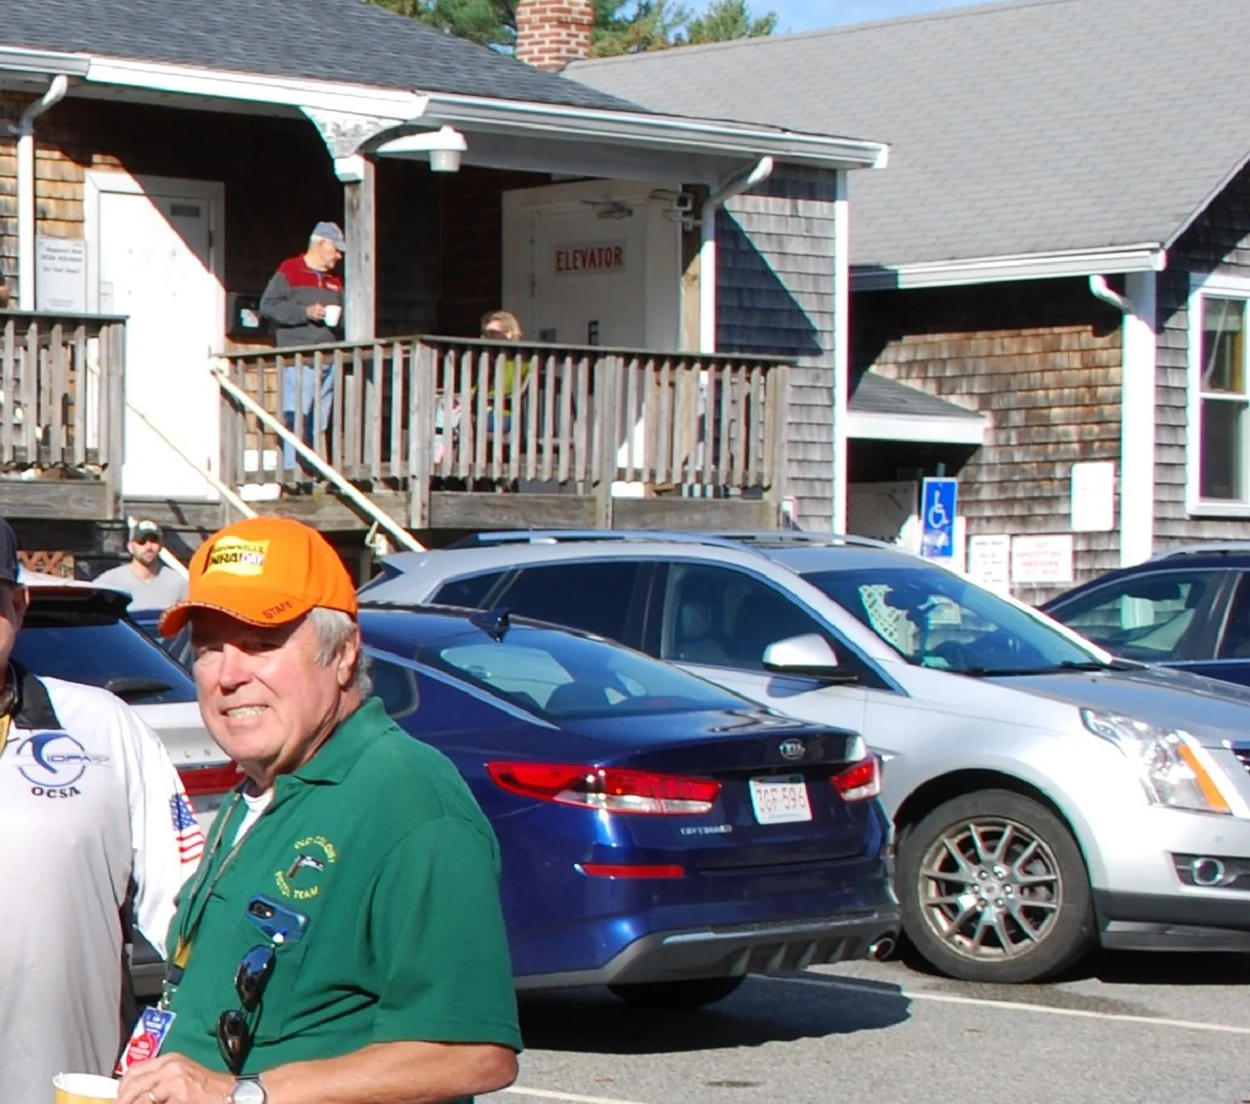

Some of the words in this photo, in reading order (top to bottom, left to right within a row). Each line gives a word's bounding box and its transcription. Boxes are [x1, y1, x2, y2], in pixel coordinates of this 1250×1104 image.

[556, 246, 623, 272] ELEVATOR
[261, 601, 295, 620] STAFF
[31, 786, 81, 799] OCSA
[293, 885, 319, 899] TEAM
